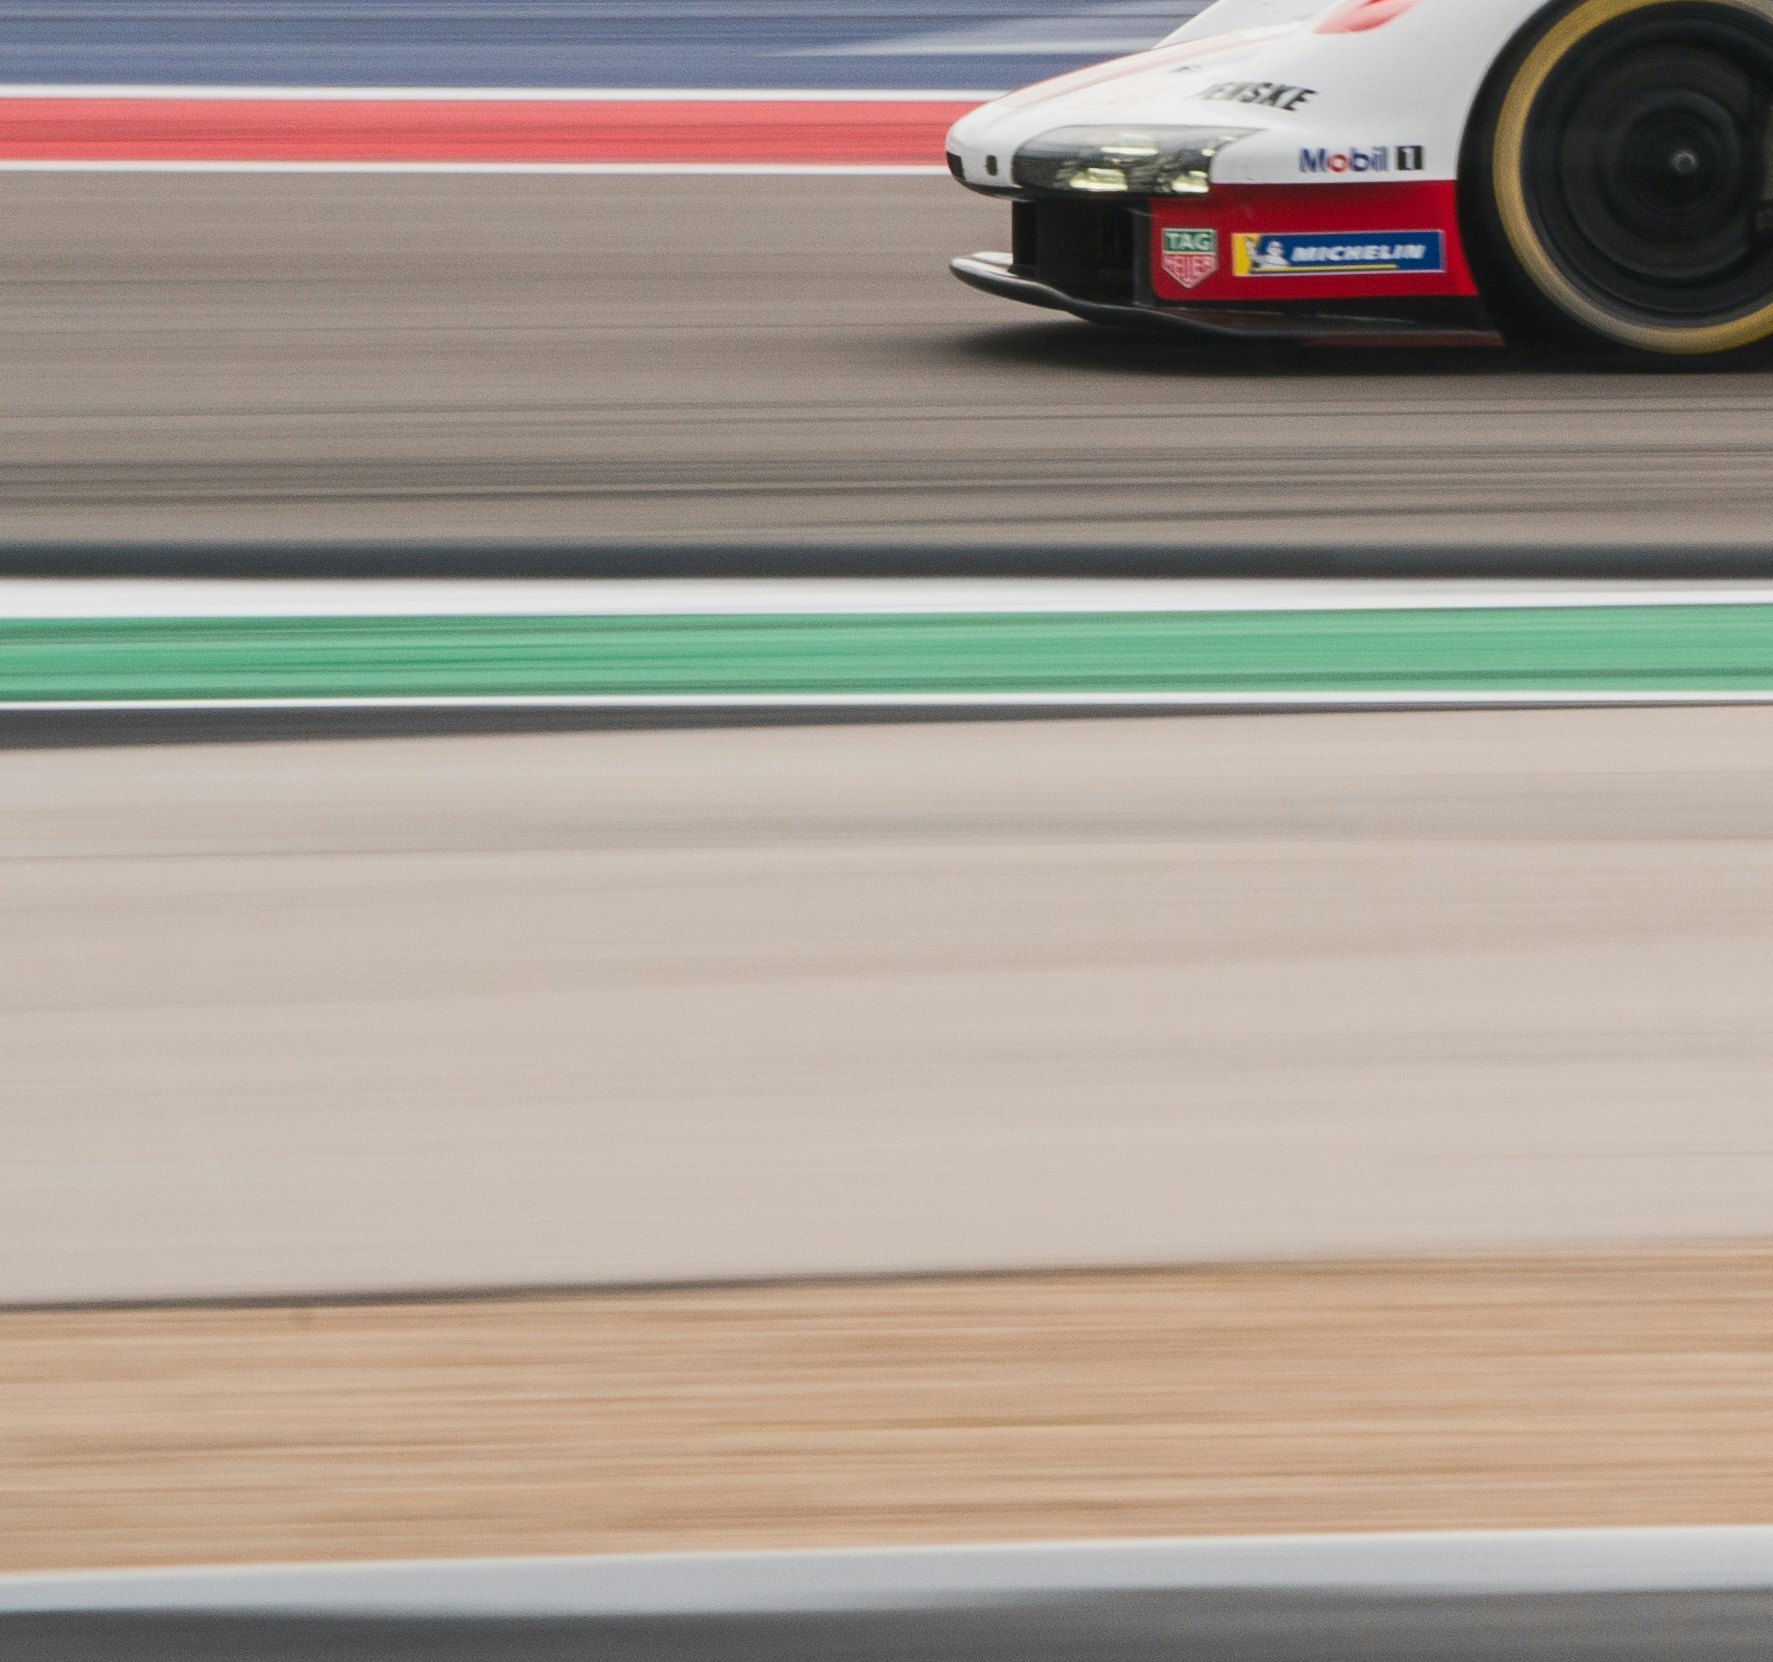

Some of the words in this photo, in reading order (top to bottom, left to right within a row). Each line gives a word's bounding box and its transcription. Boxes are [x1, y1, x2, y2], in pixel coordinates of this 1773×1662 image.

[1298, 146, 1388, 173] Mobil
[1165, 233, 1212, 252] TAG
[1290, 244, 1427, 262] MICHELIN
